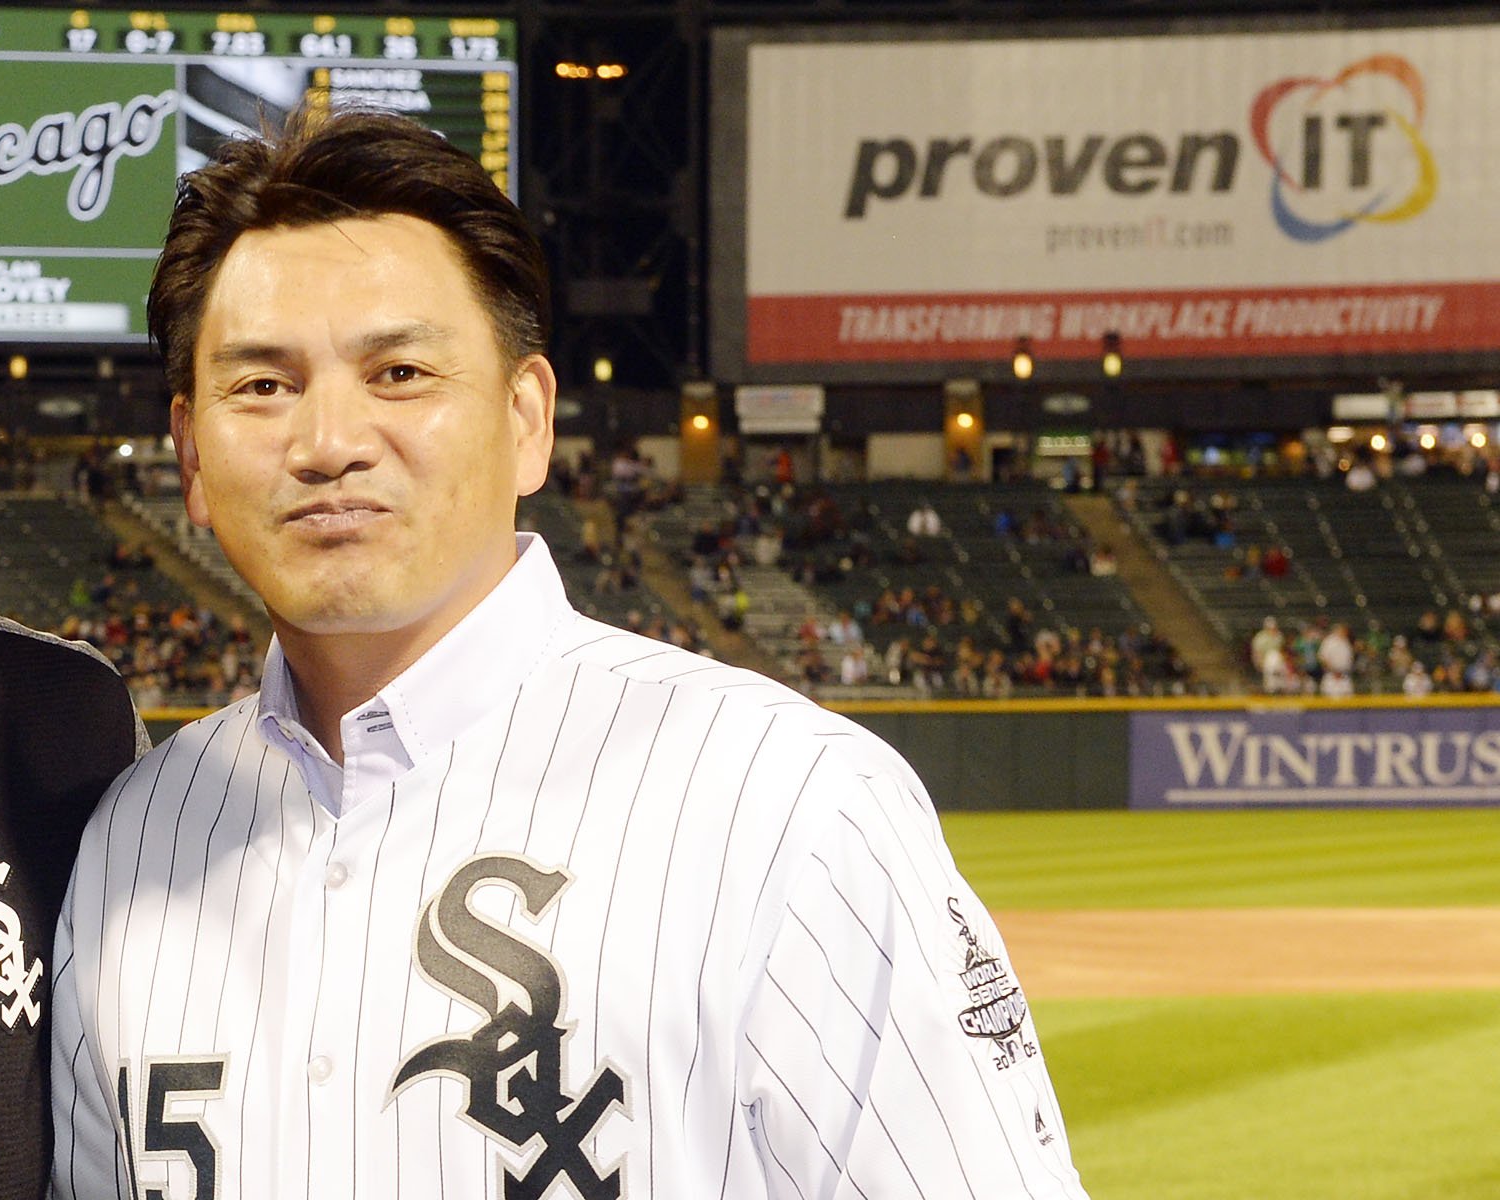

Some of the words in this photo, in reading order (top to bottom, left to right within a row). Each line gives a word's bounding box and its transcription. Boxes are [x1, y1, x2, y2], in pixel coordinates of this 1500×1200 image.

[843, 131, 1241, 219] proven
[1303, 113, 1387, 191] IT
[837, 303, 1056, 343] TRANSFORMING
[1060, 299, 1229, 341] WORKPLACE
[1232, 295, 1446, 336] PRODUCTIVITY
[960, 960, 1006, 990] WORLD
